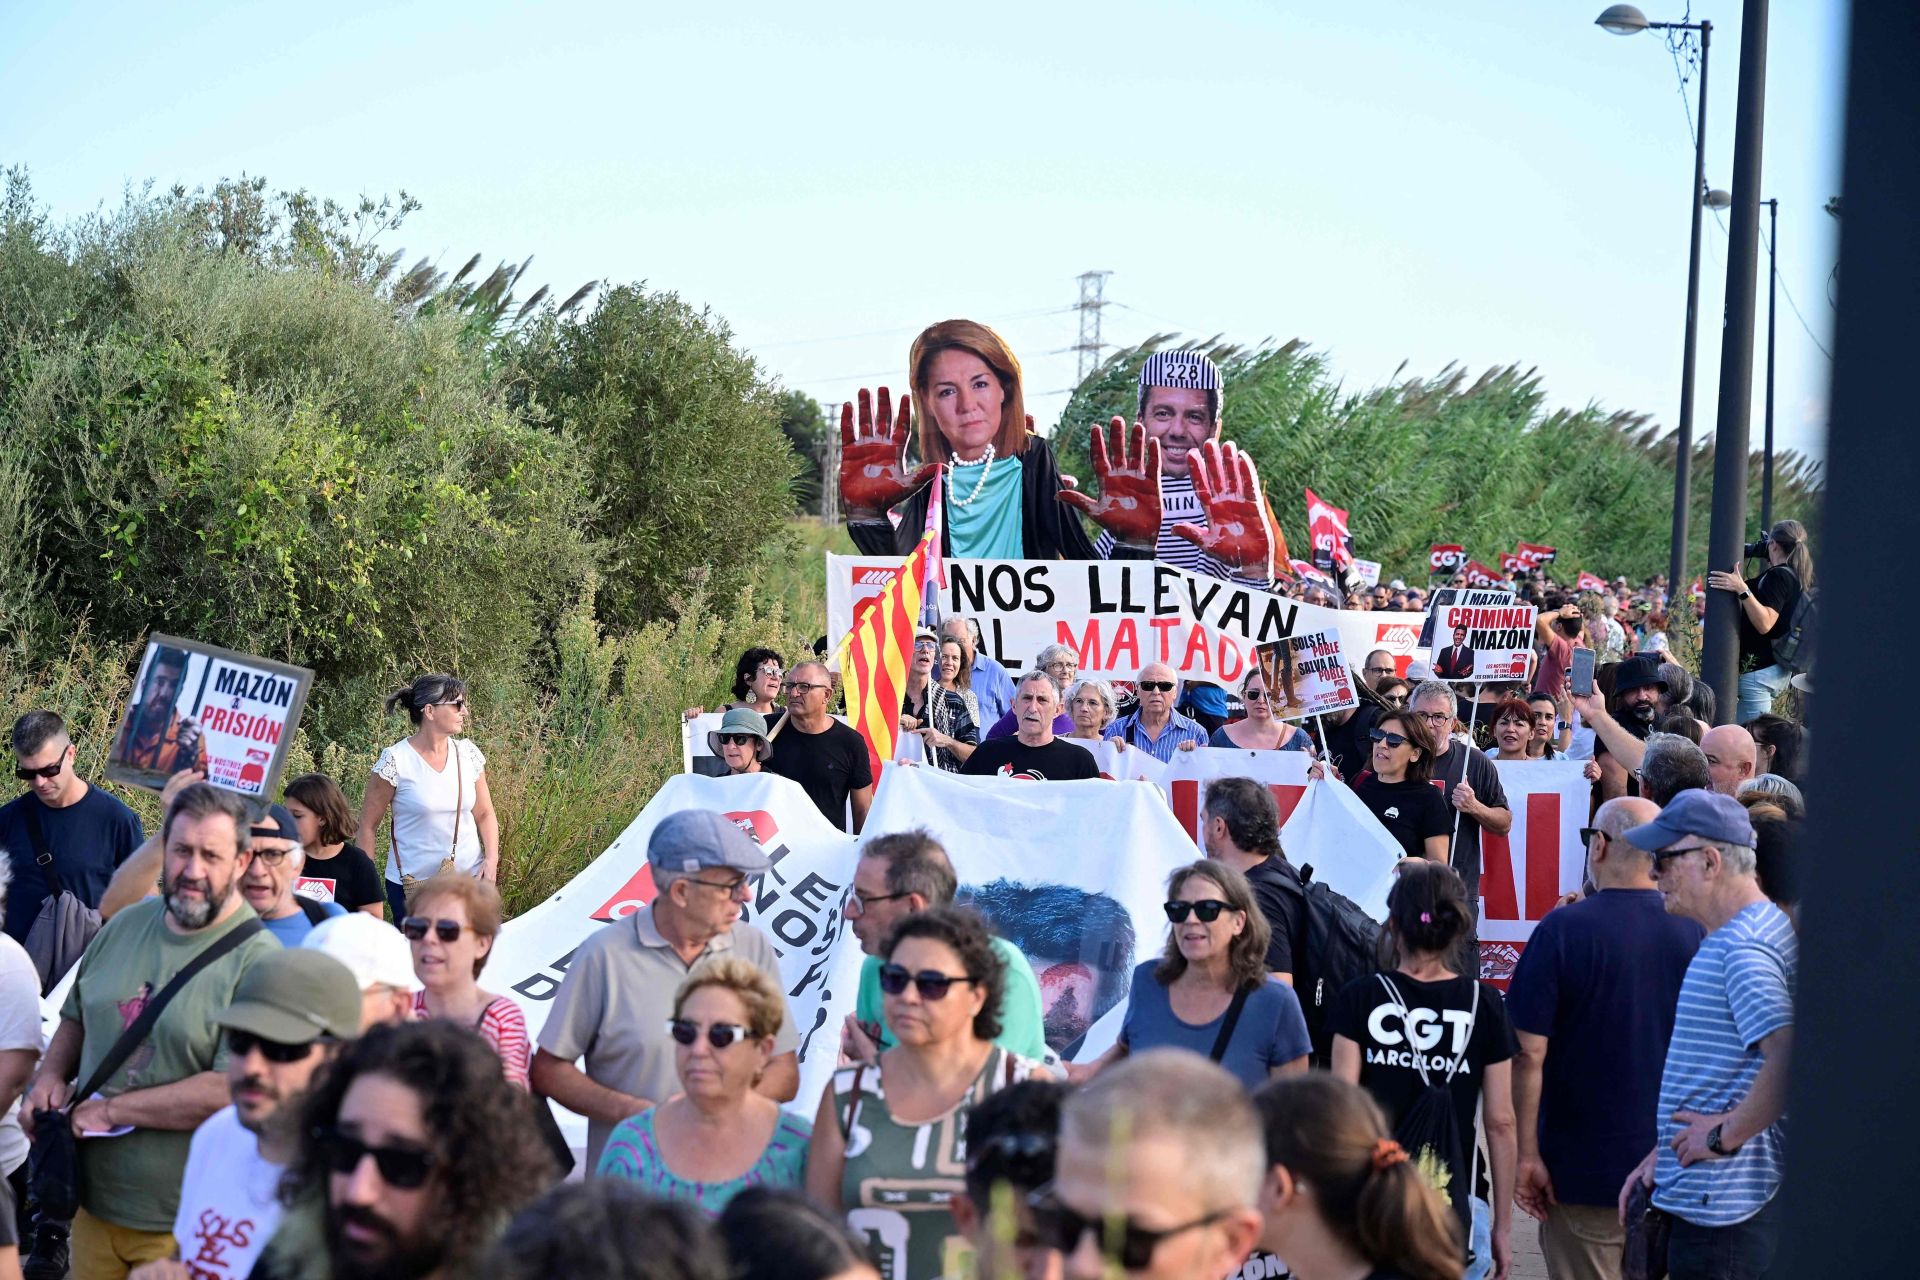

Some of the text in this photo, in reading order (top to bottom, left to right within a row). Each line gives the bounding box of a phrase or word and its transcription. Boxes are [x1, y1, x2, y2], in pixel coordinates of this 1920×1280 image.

[1166, 363, 1199, 381] 228
[1430, 550, 1468, 567] CGT
[951, 563, 1299, 643] NOS LLEVAN
[1447, 607, 1532, 629] CRIMINAL
[1291, 632, 1327, 651] SOLS EL
[1469, 625, 1531, 650] MAZÓN
[1057, 617, 1258, 683] MATAD
[1312, 641, 1340, 657] POBLE
[1298, 655, 1340, 675] SALVA AL
[1318, 666, 1346, 682] POBLE
[214, 667, 293, 708] MAZÓN
[1341, 698, 1355, 707] CGT
[200, 705, 283, 744] PRISIÓN
[1367, 1002, 1474, 1054] CGT
[1366, 1047, 1471, 1074] BARCELONA
